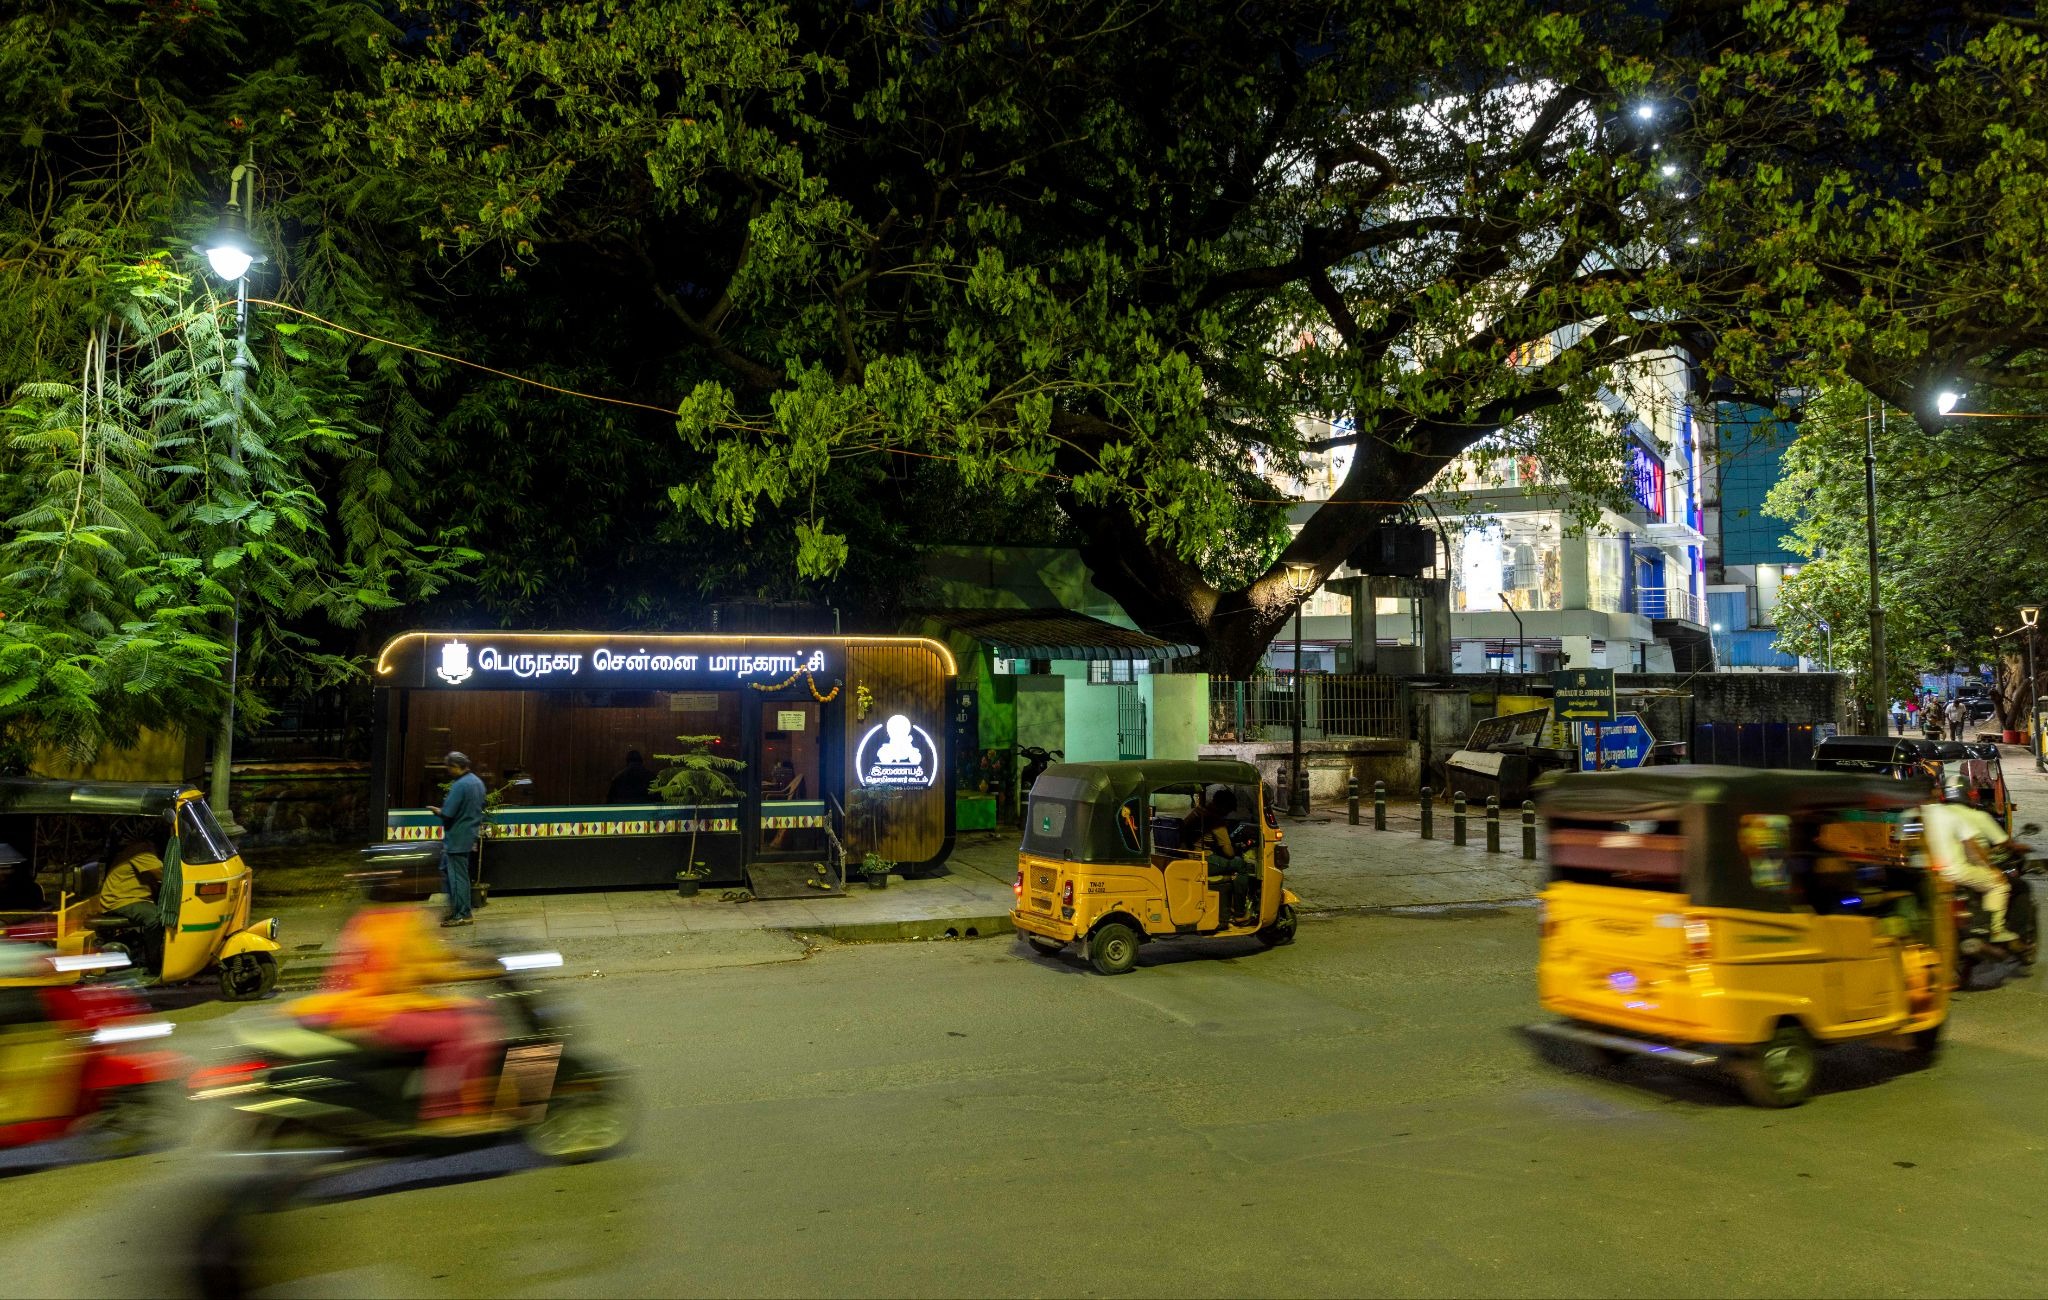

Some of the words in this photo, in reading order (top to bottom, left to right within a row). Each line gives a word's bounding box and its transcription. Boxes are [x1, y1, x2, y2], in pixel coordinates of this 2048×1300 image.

[478, 647, 582, 678] பெருநகர
[593, 648, 699, 671] சென்னை
[709, 649, 825, 678] மாநகராட்சி
[1626, 746, 1638, 759] Road
